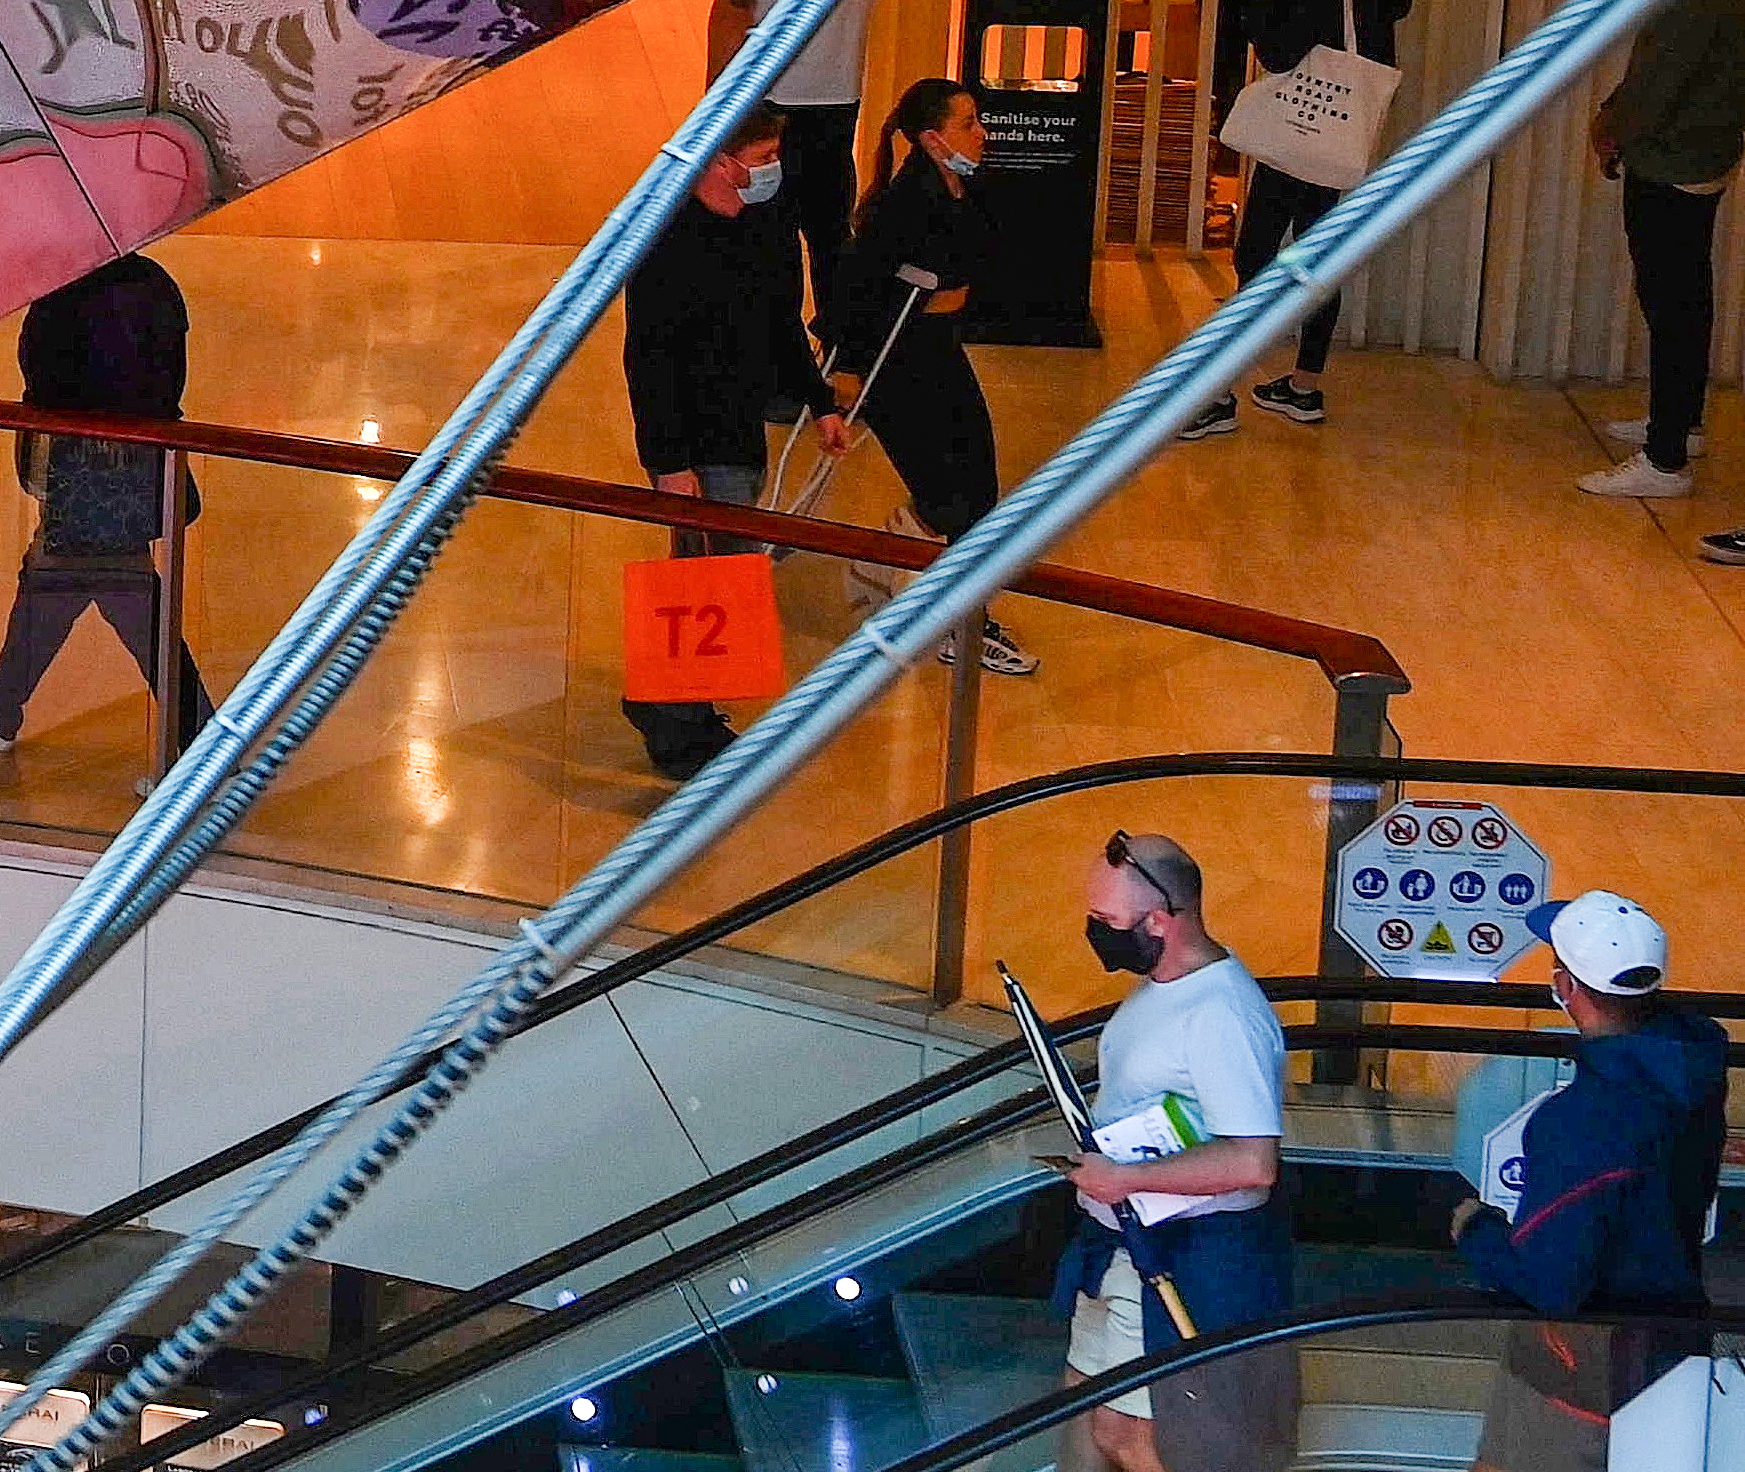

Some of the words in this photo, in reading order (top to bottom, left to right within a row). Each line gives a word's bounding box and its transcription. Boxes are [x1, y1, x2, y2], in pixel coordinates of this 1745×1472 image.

[1294, 84, 1334, 103] ROAD
[1275, 91, 1349, 121] CLOTHING
[980, 112, 1040, 126] Sanitise
[1043, 116, 1077, 129] your
[1297, 110, 1316, 122] CO
[1027, 129, 1066, 143] here.
[654, 604, 729, 659] T2
